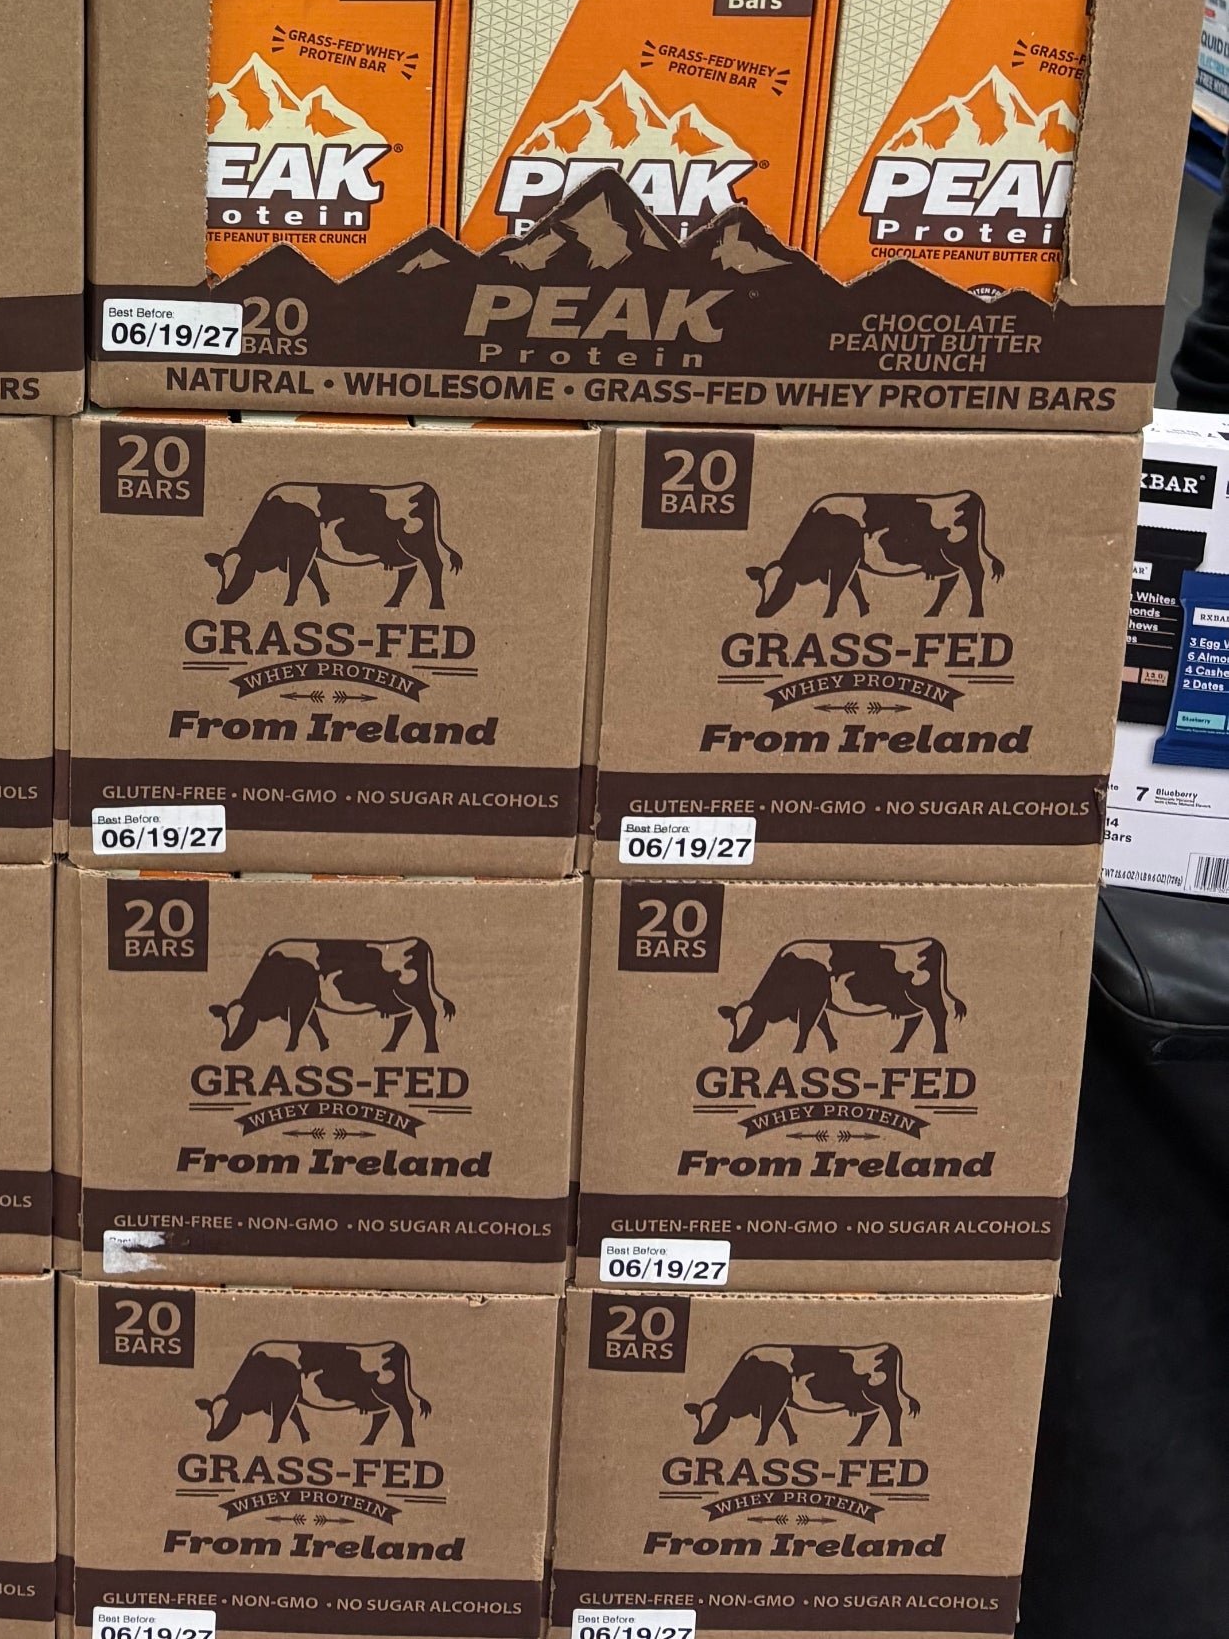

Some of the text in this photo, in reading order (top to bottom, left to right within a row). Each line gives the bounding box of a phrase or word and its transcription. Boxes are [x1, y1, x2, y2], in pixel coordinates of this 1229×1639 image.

[1137, 591, 1176, 605] Whites
[1189, 637, 1221, 650] 3 Egg
[1183, 679, 1224, 691] 2 Dates
[1136, 786, 1198, 802] 7 Blueberry
[608, 1258, 727, 1280] 06/19/27
[661, 1457, 930, 1488] GRASS-FED
[642, 1531, 947, 1558] From Ireland
